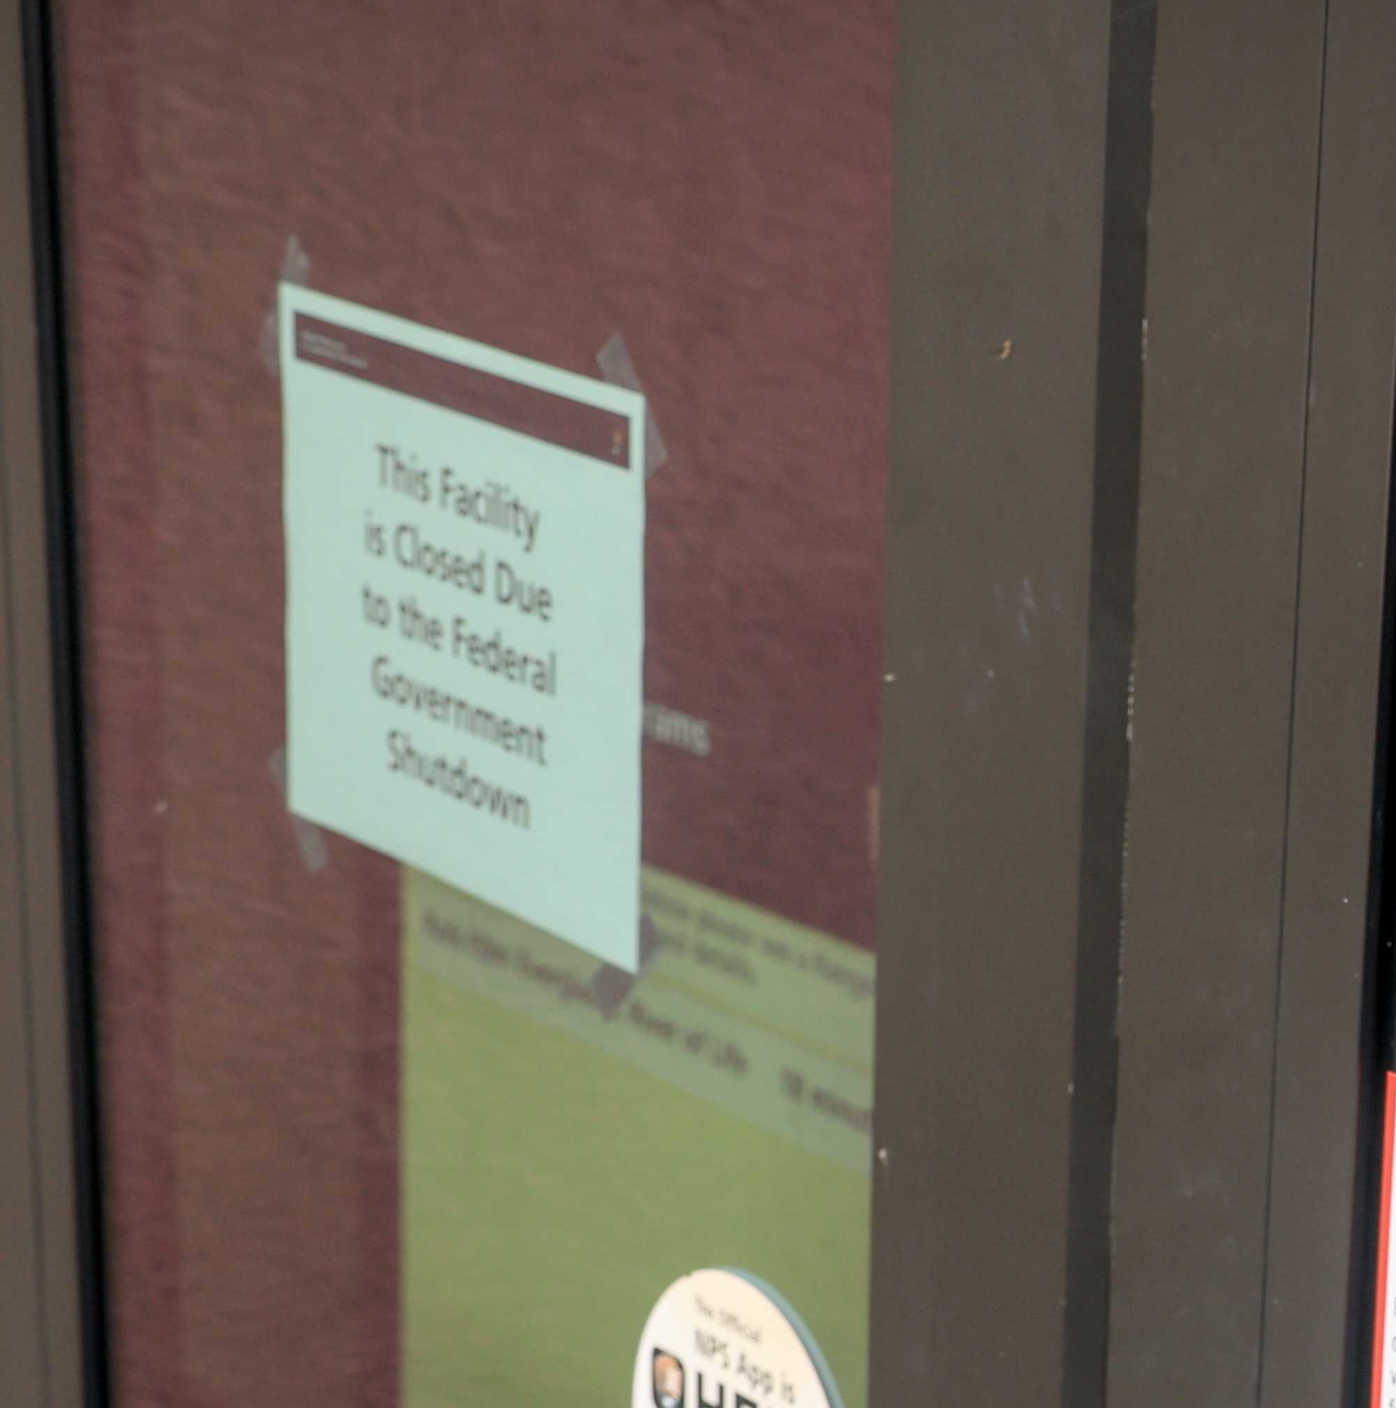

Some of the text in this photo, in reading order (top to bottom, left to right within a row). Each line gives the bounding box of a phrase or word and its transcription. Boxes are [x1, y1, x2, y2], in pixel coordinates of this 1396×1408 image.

[374, 442, 540, 554] This Facility
[364, 511, 553, 623] is Closed Due
[361, 585, 556, 695] to the Federal
[370, 655, 547, 766] Government
[386, 729, 530, 828] Shutdown
[694, 1328, 794, 1404] NPS App is
